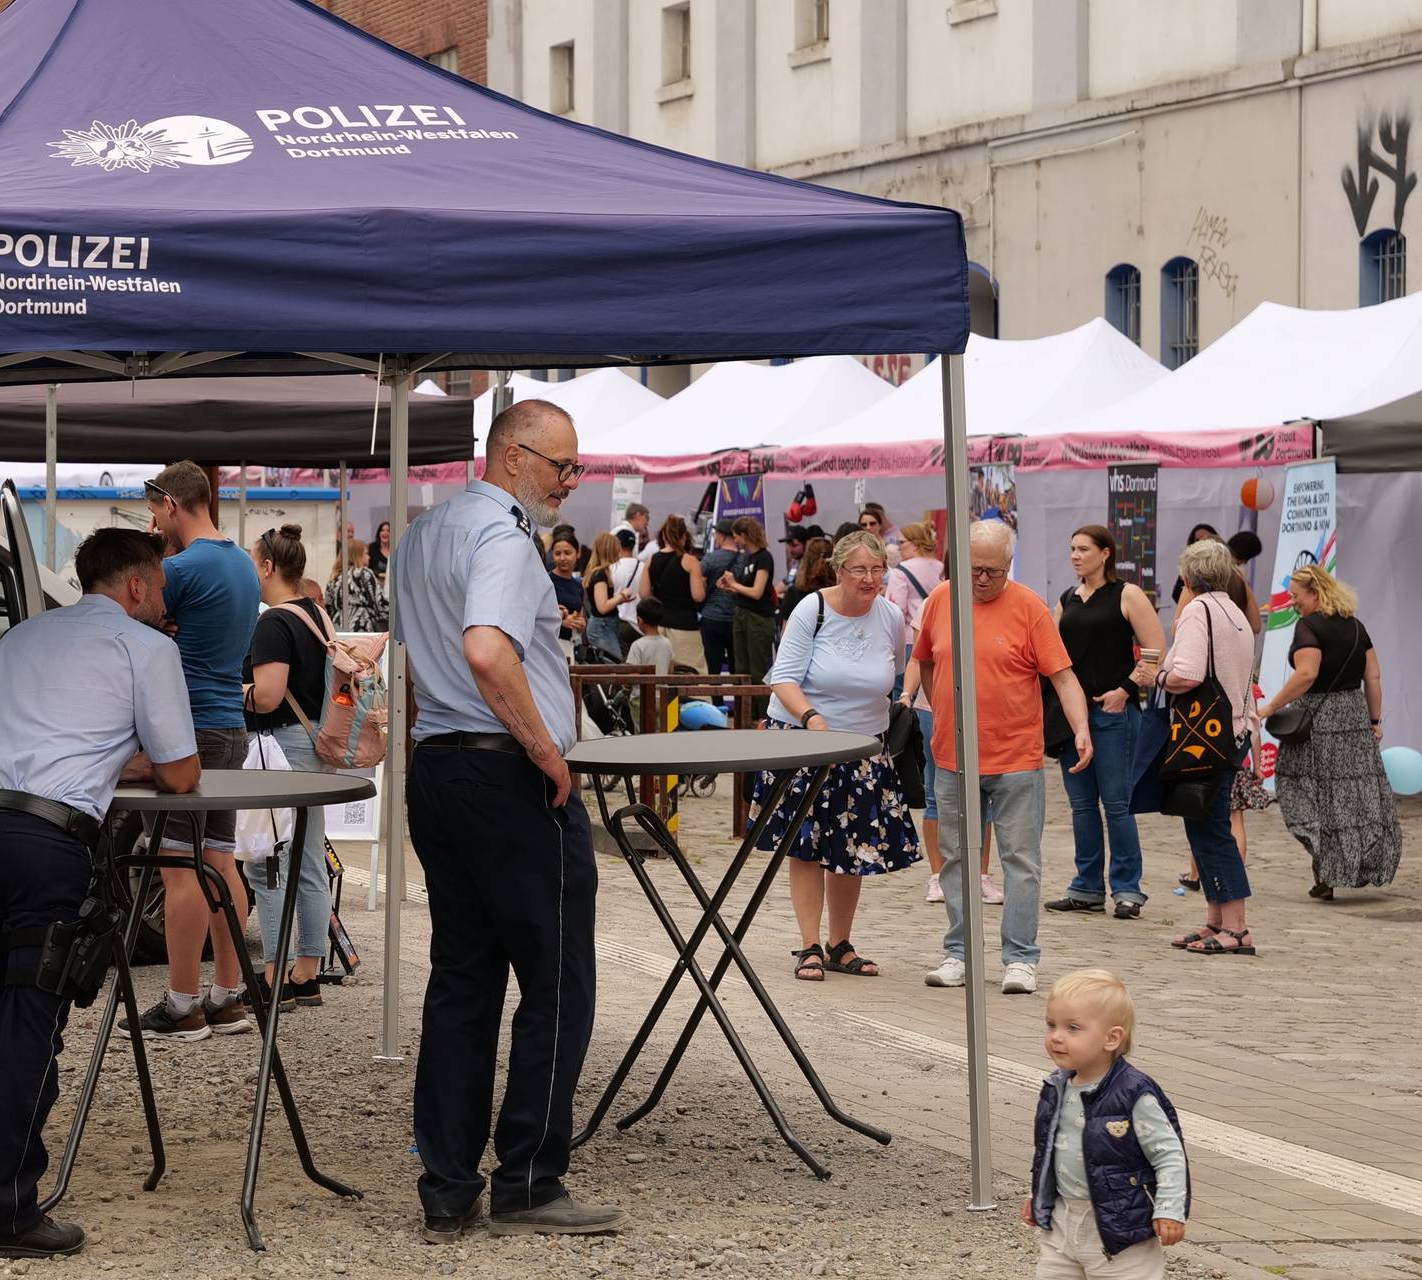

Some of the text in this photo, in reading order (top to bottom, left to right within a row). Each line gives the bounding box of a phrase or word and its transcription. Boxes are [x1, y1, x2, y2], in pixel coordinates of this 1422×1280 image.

[255, 105, 467, 131] POLIZEI
[274, 128, 519, 145] Nordrhein-Westfalen
[285, 144, 412, 159] Dortmund
[1110, 468, 1157, 493] vhs Dortmund
[1188, 701, 1201, 718] D
[1171, 719, 1222, 741] T O
